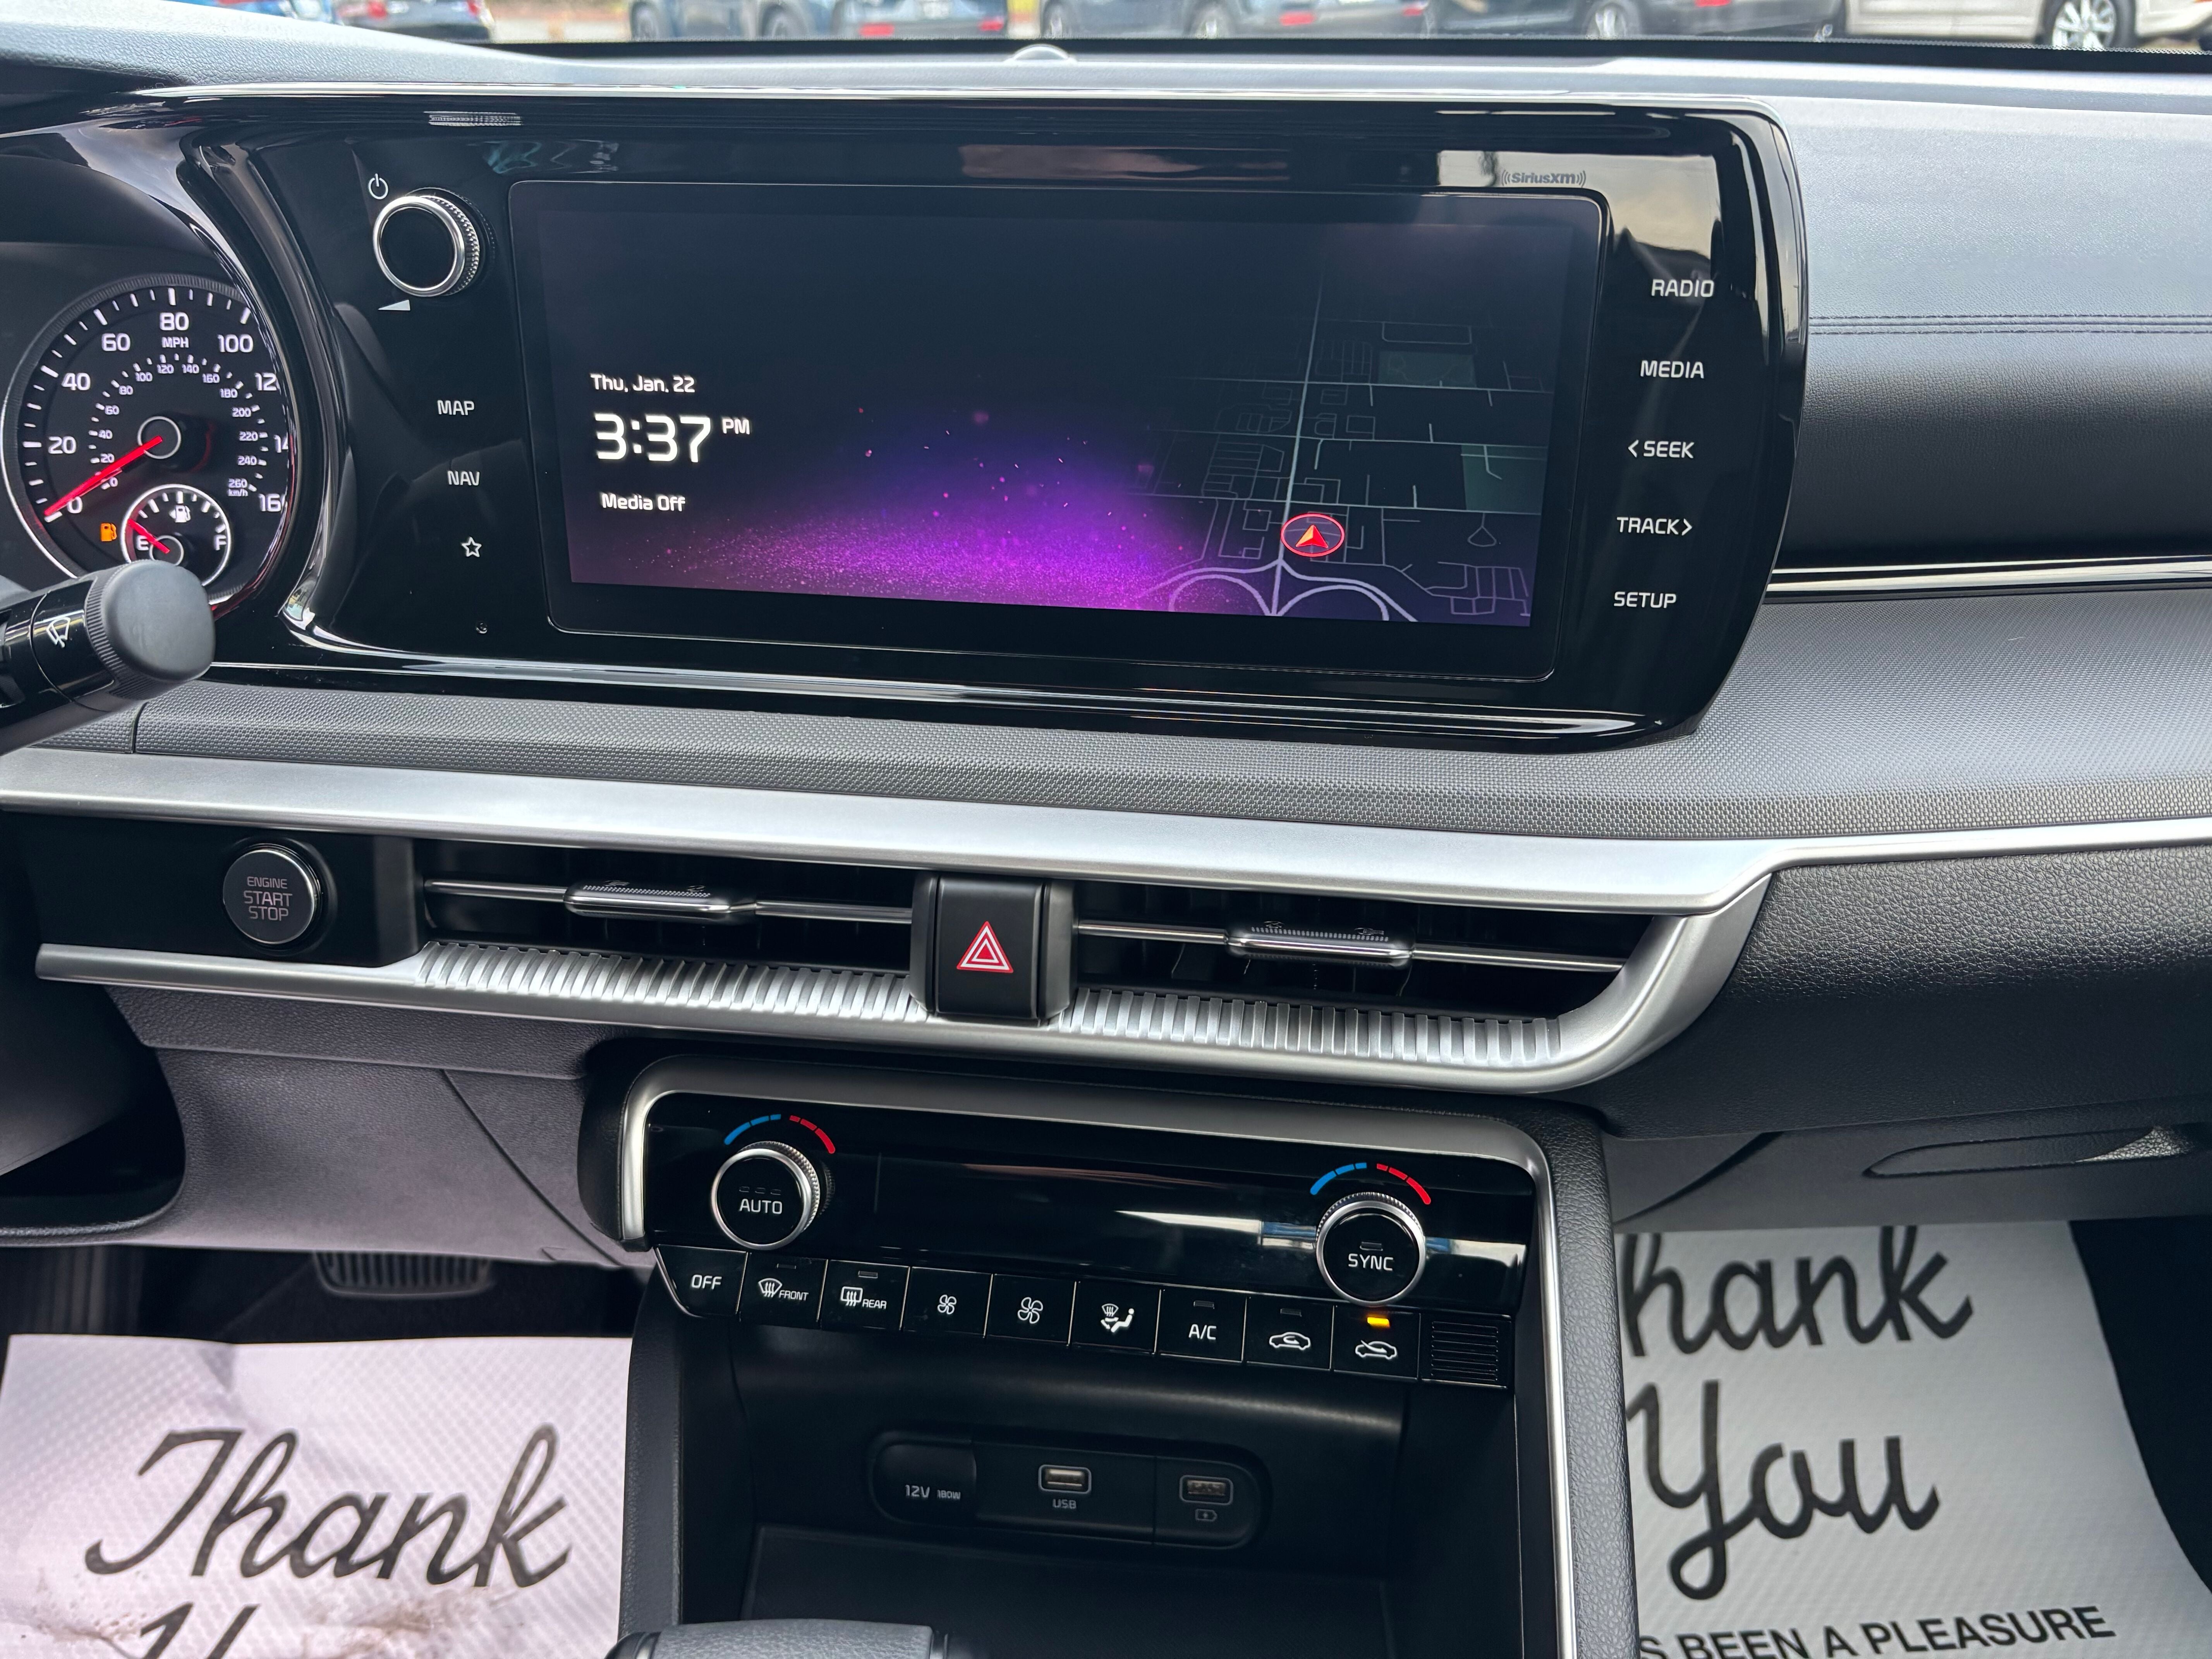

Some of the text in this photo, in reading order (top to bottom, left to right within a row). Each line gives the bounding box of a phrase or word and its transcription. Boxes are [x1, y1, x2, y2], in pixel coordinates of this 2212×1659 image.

[1652, 279, 1714, 297] RADIO
[160, 312, 189, 331] 80
[101, 333, 131, 351] 60
[161, 337, 189, 348] MPH
[218, 334, 254, 353] 100
[136, 372, 153, 382] 100
[157, 364, 174, 374] 120
[182, 364, 199, 374] 140
[1640, 360, 1704, 378] MEDIA
[61, 373, 91, 391] 40
[202, 373, 220, 383] 160
[255, 373, 281, 391] 12
[590, 373, 695, 393] Thu, Jan. 22
[119, 385, 133, 395] 80
[220, 388, 238, 398] 180
[105, 405, 120, 415] 60
[232, 407, 251, 417] 200
[437, 400, 474, 416] MAP
[98, 429, 113, 439] 40
[239, 431, 258, 441] 220
[595, 413, 750, 463] 3:37 PM
[48, 436, 76, 454] 20
[1644, 441, 1694, 459] SEEK
[101, 453, 115, 463] 20
[238, 455, 257, 465] 240
[228, 478, 248, 488] 260
[447, 471, 480, 486] NAV
[67, 496, 83, 514] 0
[601, 493, 685, 512] Media Off
[1617, 517, 1679, 535] TRACK
[136, 535, 149, 551] E
[215, 534, 227, 550] F
[1614, 591, 1676, 608] SETUP
[247, 876, 287, 889] ENGINE
[244, 890, 293, 907] START
[249, 905, 289, 921] STOP
[739, 1199, 782, 1214] AUTO
[1348, 1253, 1393, 1271] SYNC
[691, 1274, 722, 1290] OFF
[779, 1290, 809, 1301] FRONT
[1621, 1225, 1973, 1357] hank
[862, 1299, 887, 1309] REAR
[1188, 1324, 1217, 1340] A/C
[905, 1484, 930, 1498] 12V
[1626, 1379, 1939, 1600] You
[84, 1423, 572, 1588] Thank
[1053, 1499, 1077, 1510] USB
[1676, 1628, 1810, 1659] BEEN
[1824, 1626, 1860, 1658] A
[1860, 1606, 2116, 1655] PLEASURE
